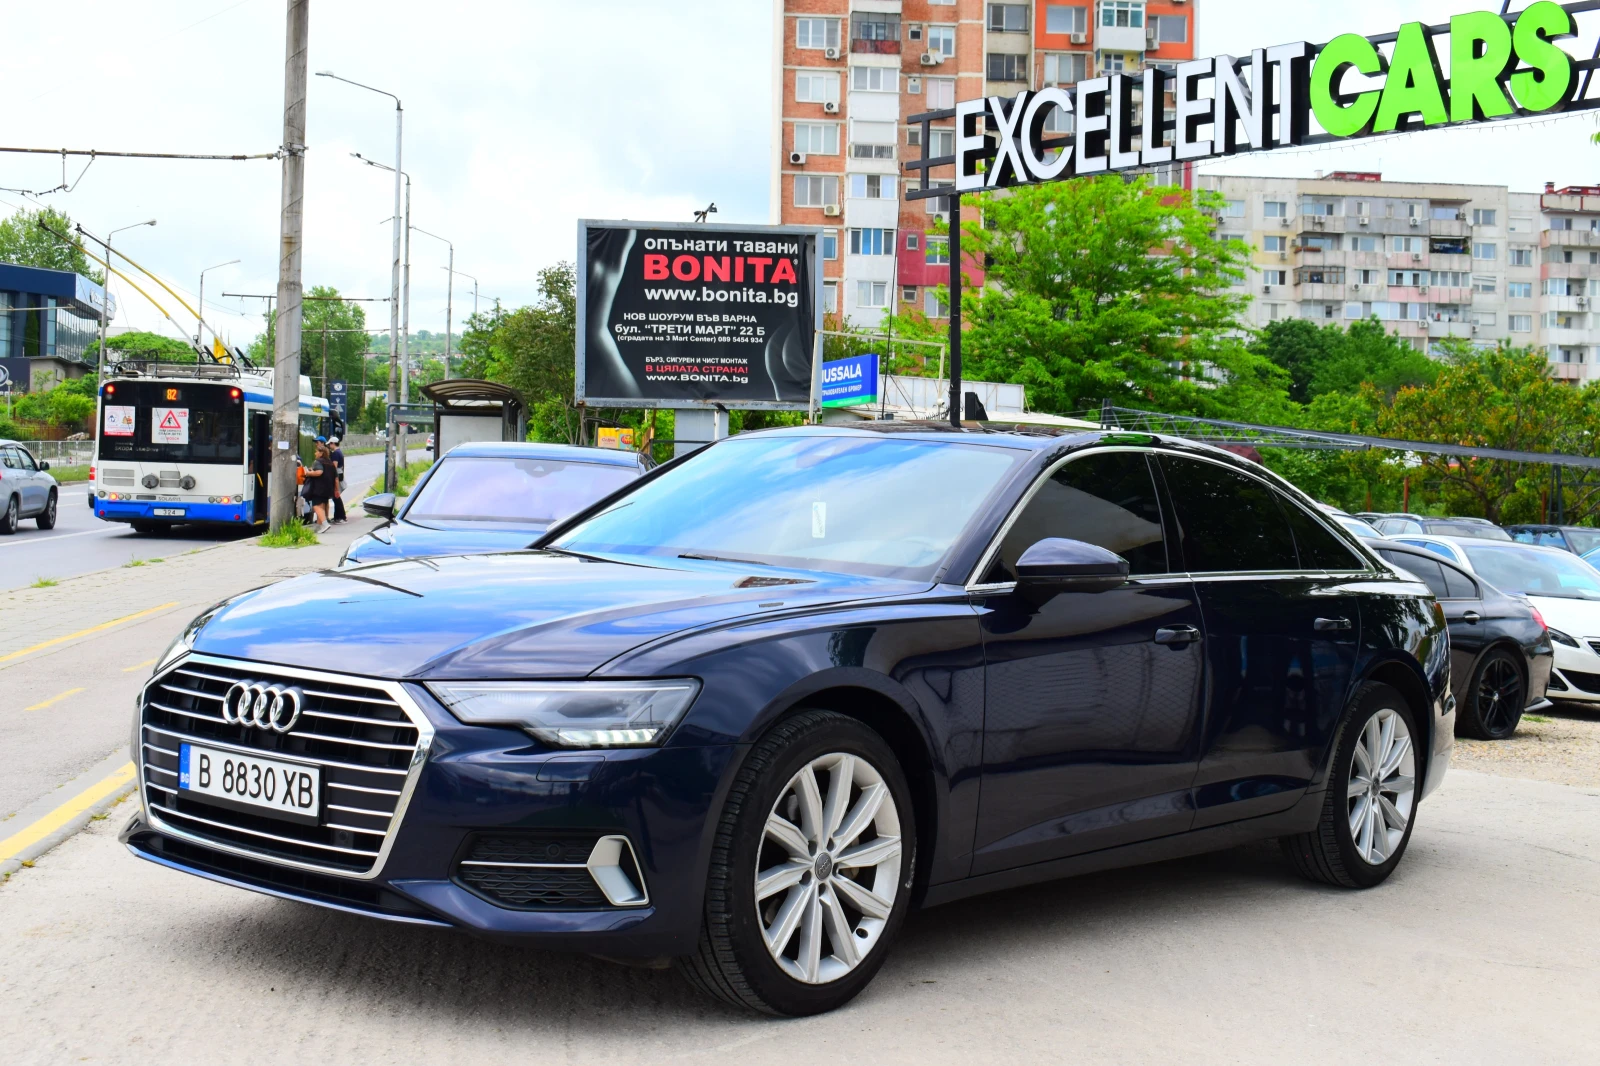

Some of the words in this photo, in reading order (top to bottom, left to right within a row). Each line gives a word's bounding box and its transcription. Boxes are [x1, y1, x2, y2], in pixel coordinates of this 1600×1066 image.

[955, 41, 1308, 191] EXCELLENT
[1309, 1, 1572, 137] CARS
[644, 238, 728, 252] опънати
[733, 240, 799, 254] тавани
[644, 287, 799, 307] www.bonita.bg
[623, 313, 646, 321] НОВ
[648, 313, 694, 321] ШОУРУМ
[697, 314, 720, 322] ВЪВ
[723, 315, 757, 323] ВАРНА
[615, 324, 641, 334] бул.
[739, 327, 753, 335] 22
[756, 327, 765, 336] Б
[656, 365, 699, 373] ЦЯЛАТА
[702, 366, 748, 374] СТРАНА!
[646, 374, 749, 384] www.BONITA.bg
[166, 388, 177, 400] 82
[180, 772, 190, 783] BG
[199, 754, 211, 788] B
[222, 759, 276, 801] 8830
[282, 769, 313, 809] XB
